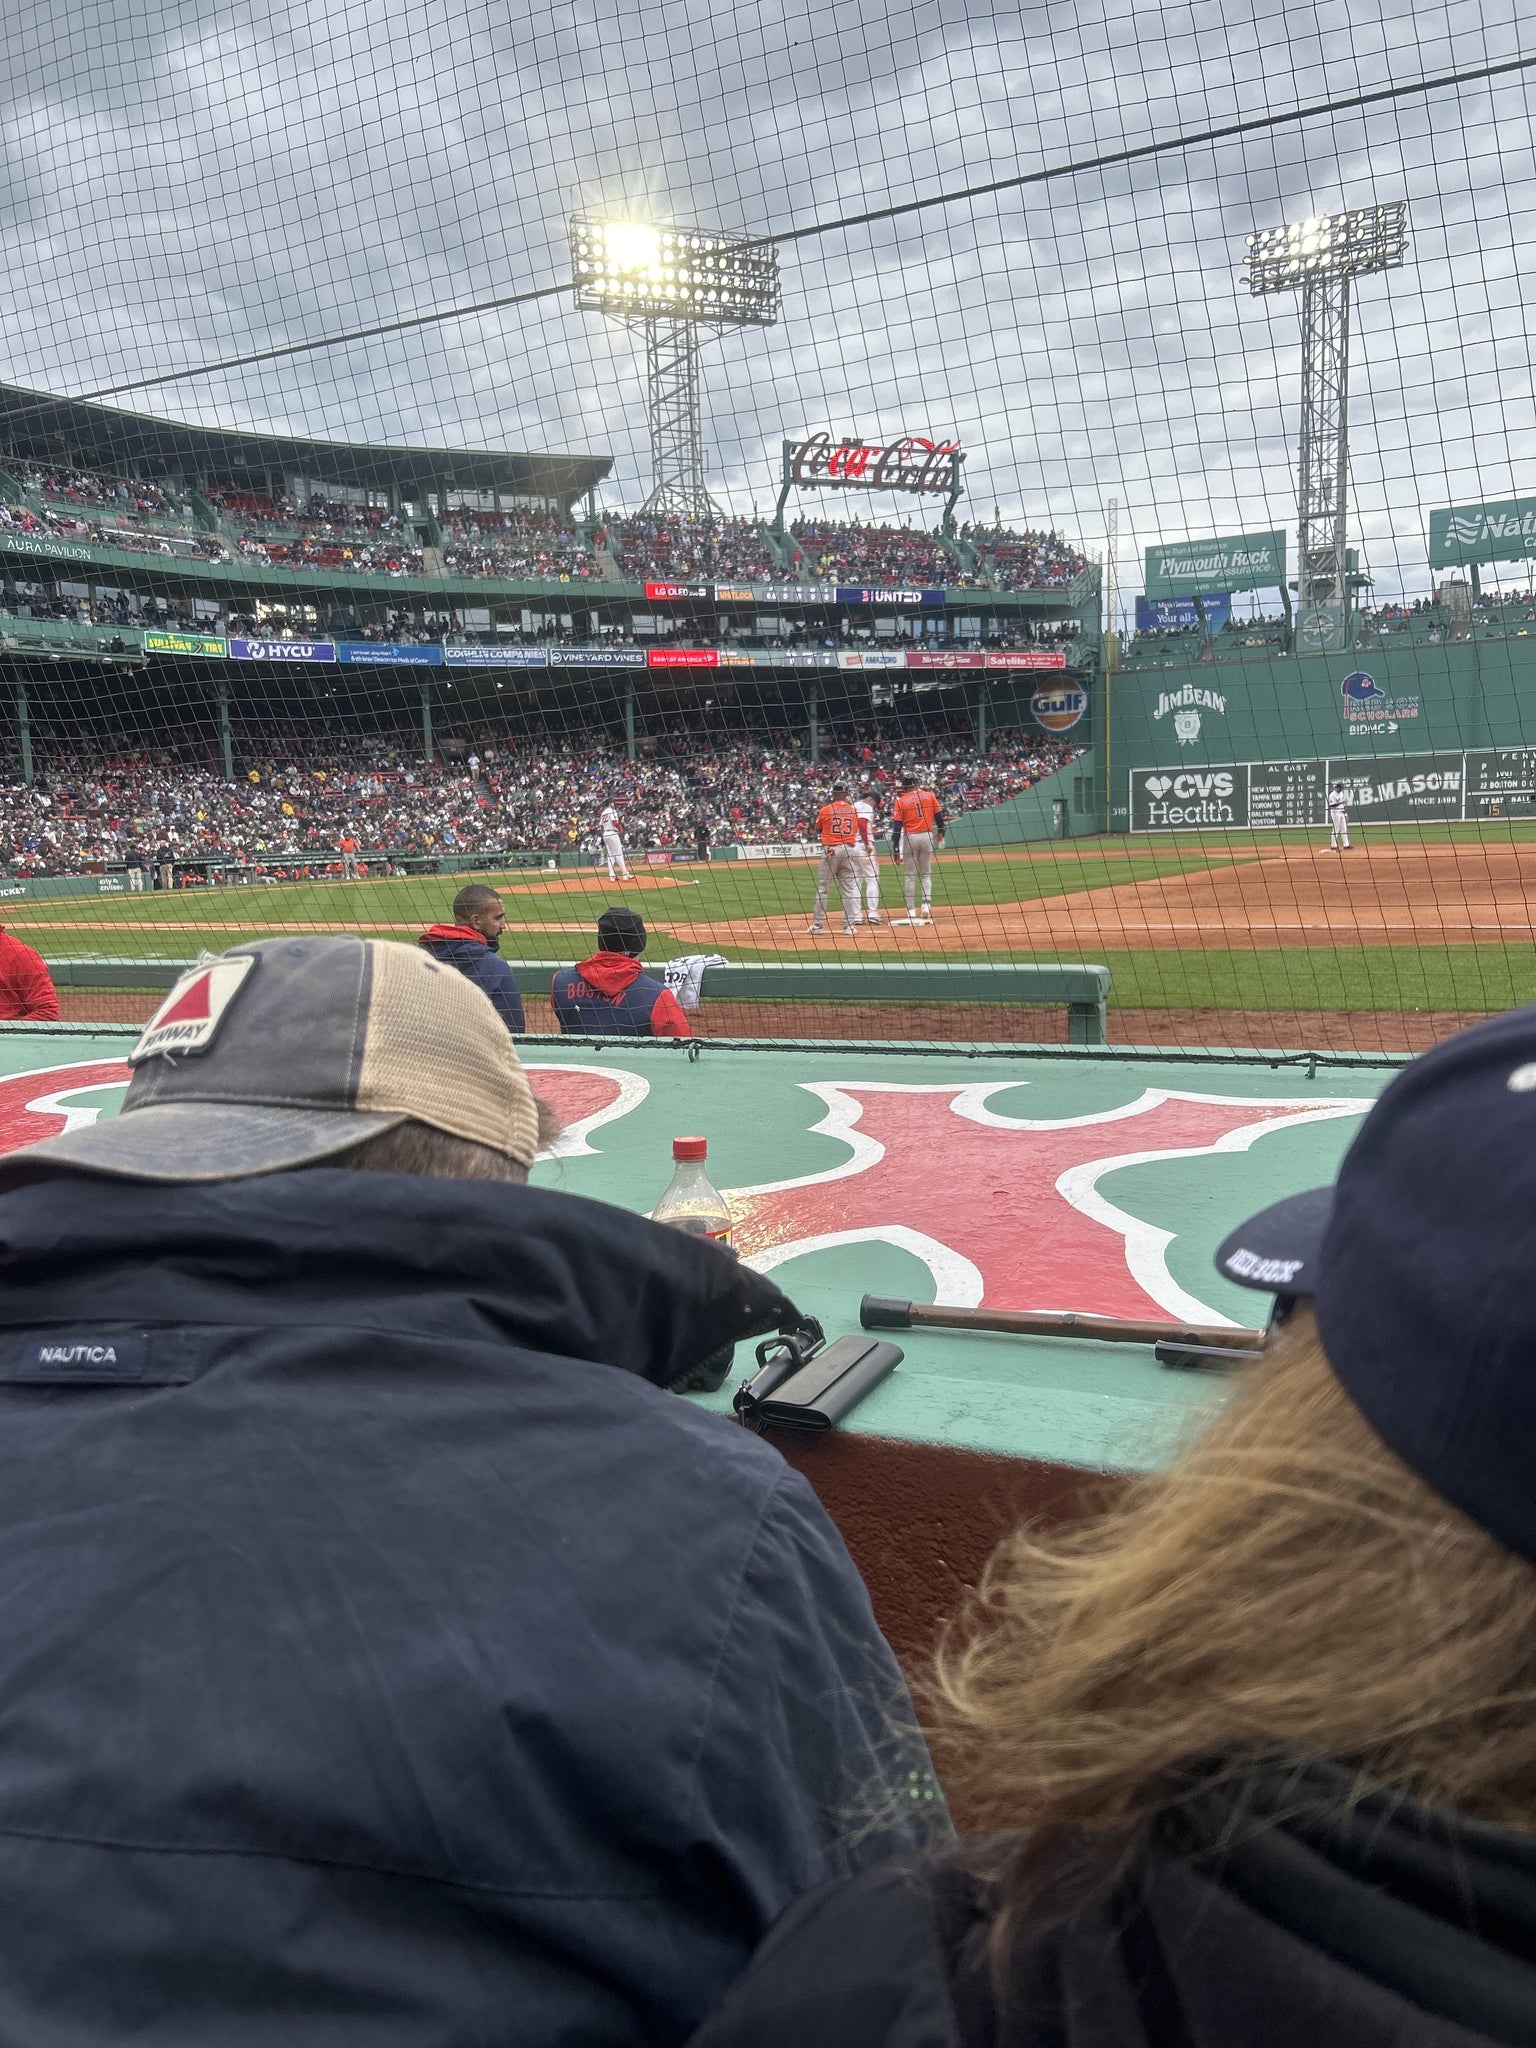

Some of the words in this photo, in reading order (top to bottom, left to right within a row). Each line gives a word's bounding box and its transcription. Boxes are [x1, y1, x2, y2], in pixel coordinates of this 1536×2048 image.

[791, 431, 961, 493] Coca-Cola
[45, 543, 91, 560] PAVILION
[1159, 553, 1229, 575] Plymouth
[1231, 547, 1270, 567] Rock
[1219, 564, 1271, 577] assurance
[655, 588, 666, 596] LG
[667, 588, 688, 597] OLED
[875, 591, 922, 602] UNITED
[1156, 614, 1177, 623] Your
[204, 643, 223, 653] TIRE
[269, 645, 313, 658] HYCU
[490, 649, 546, 659] COMPANIES
[563, 653, 611, 662] VINEYARD
[613, 654, 643, 663] VINES
[1032, 693, 1083, 713] Gulf
[1153, 692, 1182, 720] JIM
[1183, 684, 1227, 716] BEAM
[1349, 708, 1419, 721] SCHOLARS
[1349, 723, 1386, 735] BIDMC
[1283, 764, 1308, 772] EAST
[1173, 772, 1234, 799] CVS
[1409, 797, 1435, 805] SINCE
[915, 802, 923, 818] 1
[1148, 799, 1234, 825] Health
[831, 815, 852, 835] 23
[39, 1346, 117, 1363] NAUTICA
